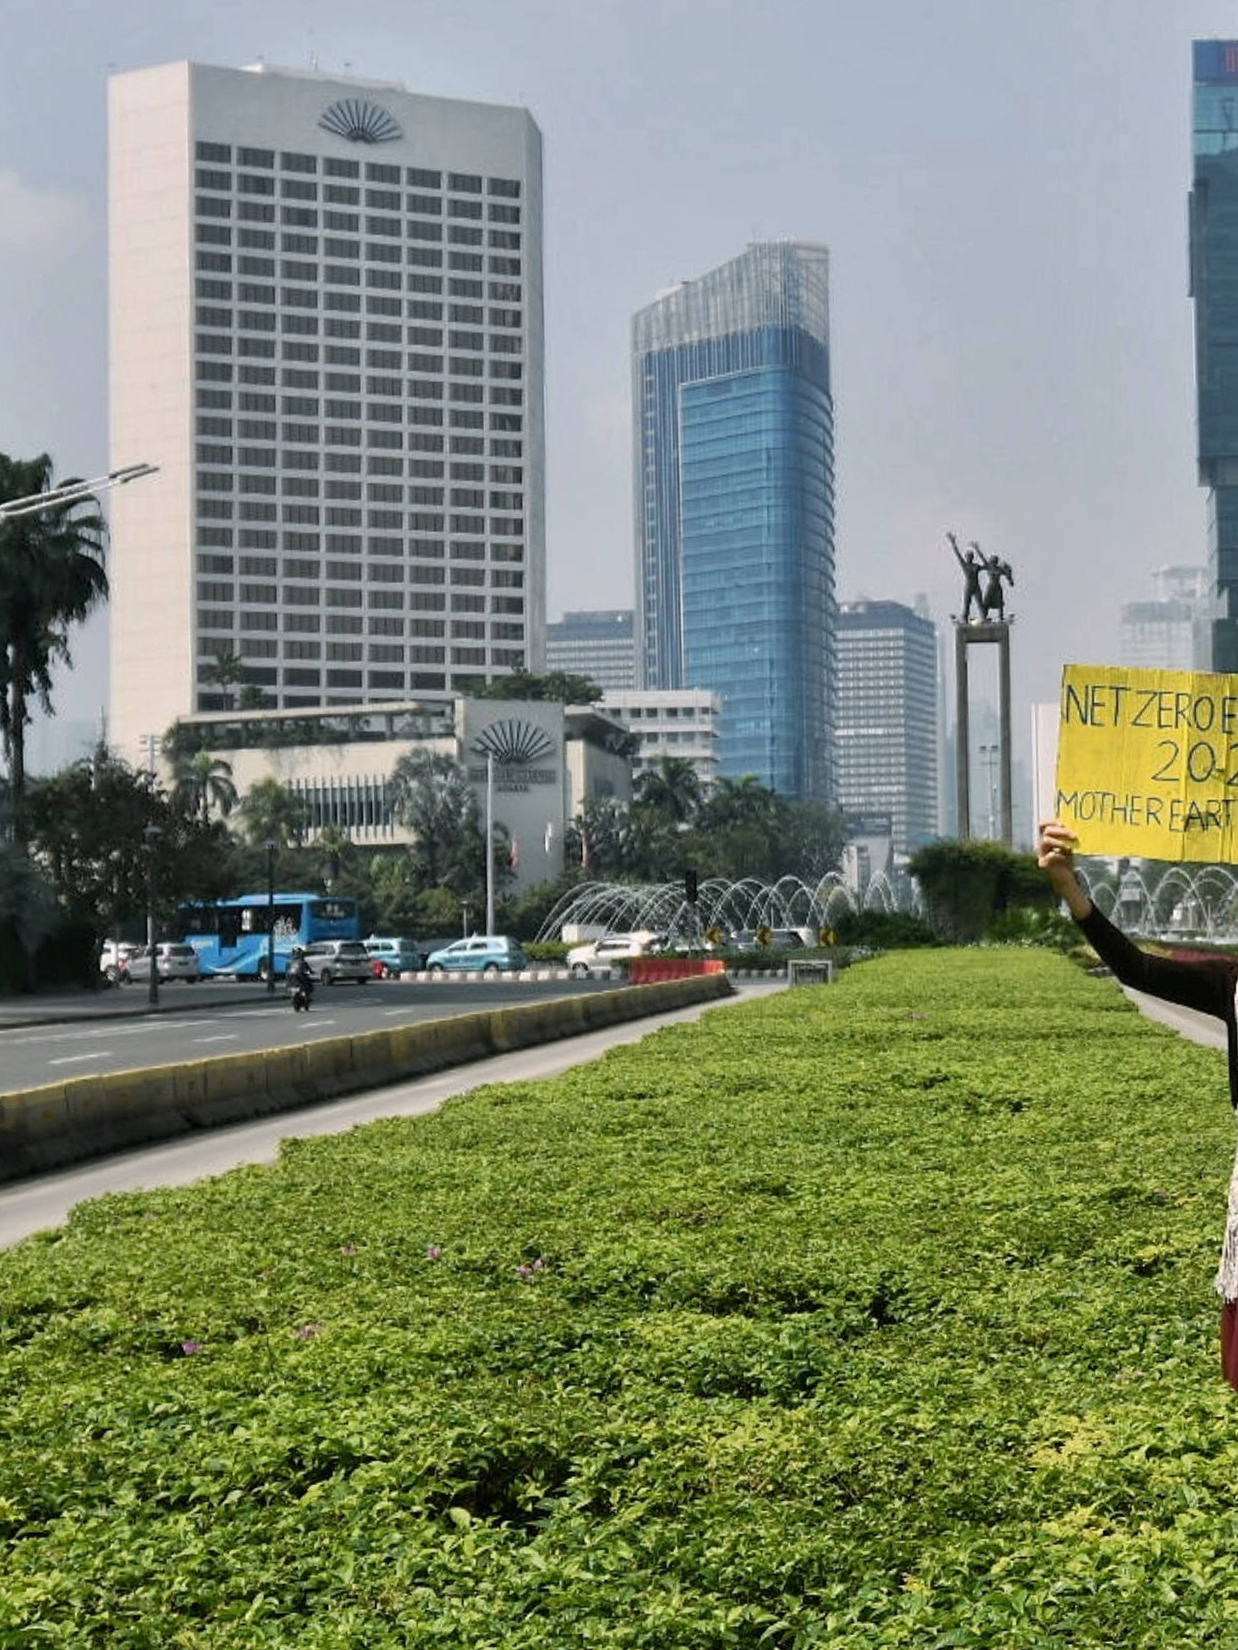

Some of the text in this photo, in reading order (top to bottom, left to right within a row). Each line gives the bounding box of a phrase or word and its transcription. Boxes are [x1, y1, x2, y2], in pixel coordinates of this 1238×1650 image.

[1066, 684, 1131, 727] NET
[1131, 689, 1215, 732] ZERO
[1055, 789, 1164, 826] MOTHER
